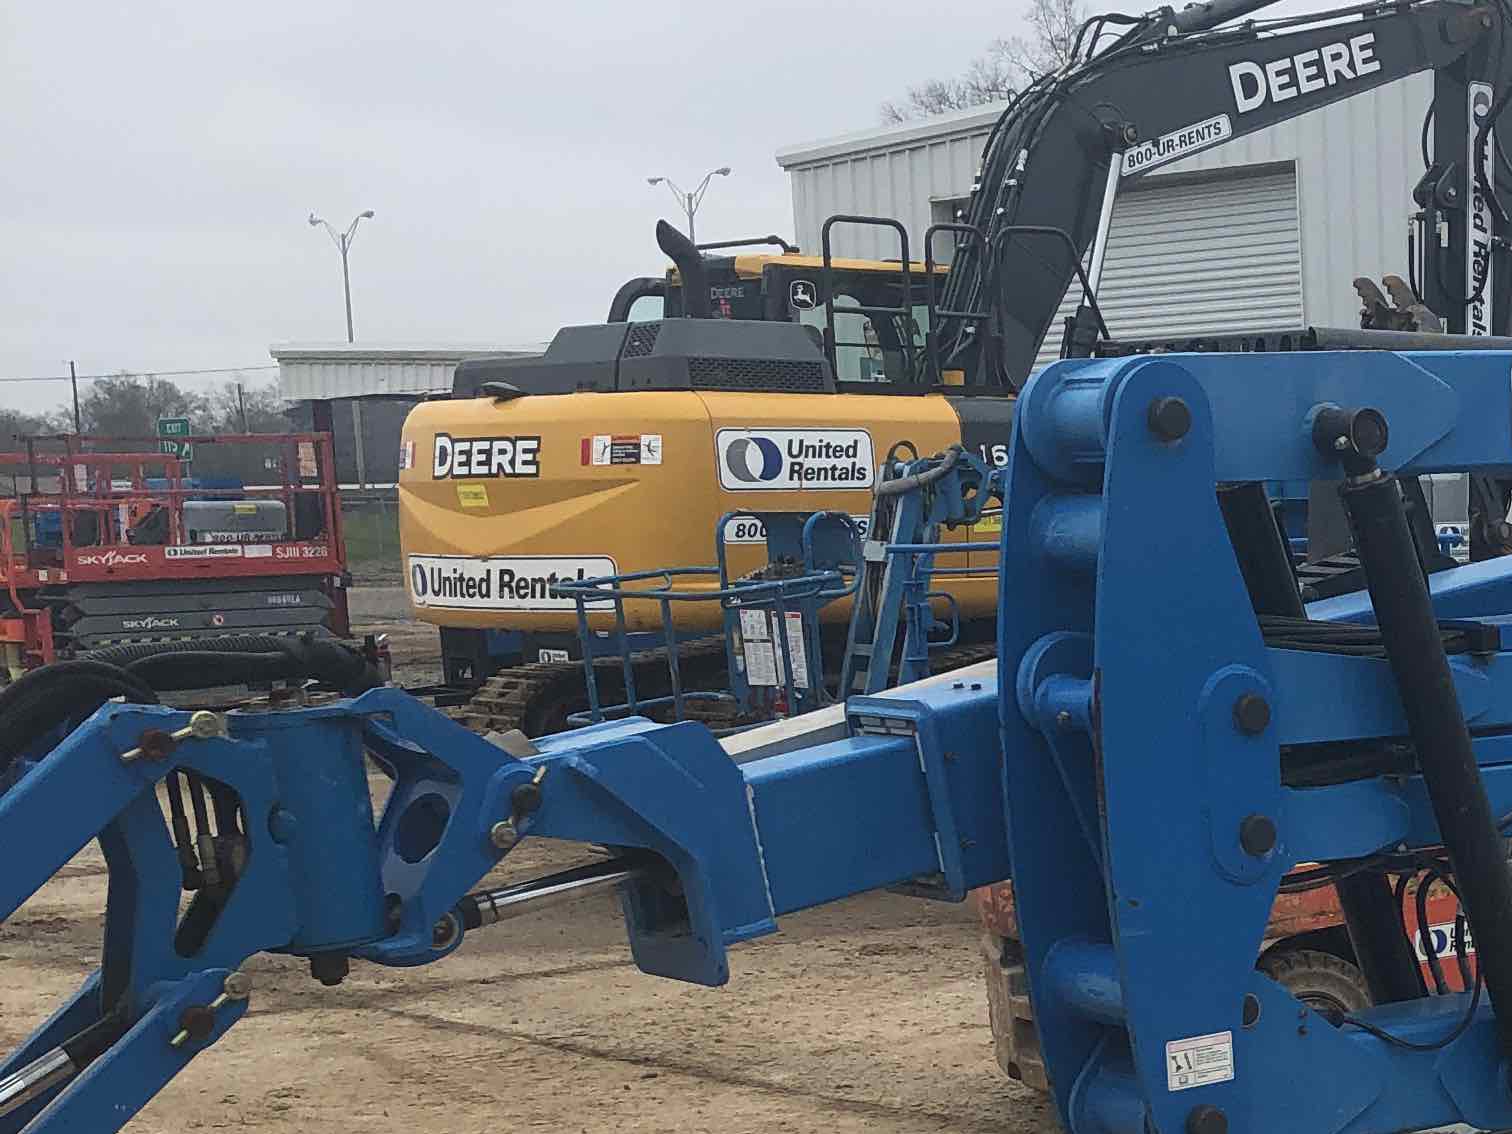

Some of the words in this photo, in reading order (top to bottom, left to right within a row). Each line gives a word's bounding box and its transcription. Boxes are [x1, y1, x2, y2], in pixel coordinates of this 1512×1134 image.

[1229, 33, 1381, 113] DEERE
[1127, 121, 1222, 168] 800-UR-RENTS
[435, 436, 539, 477] DEERE
[787, 438, 858, 459] United
[789, 461, 867, 481] Rentals
[78, 551, 148, 566] SKYJACK
[430, 567, 491, 599] United
[498, 567, 595, 600] Renta
